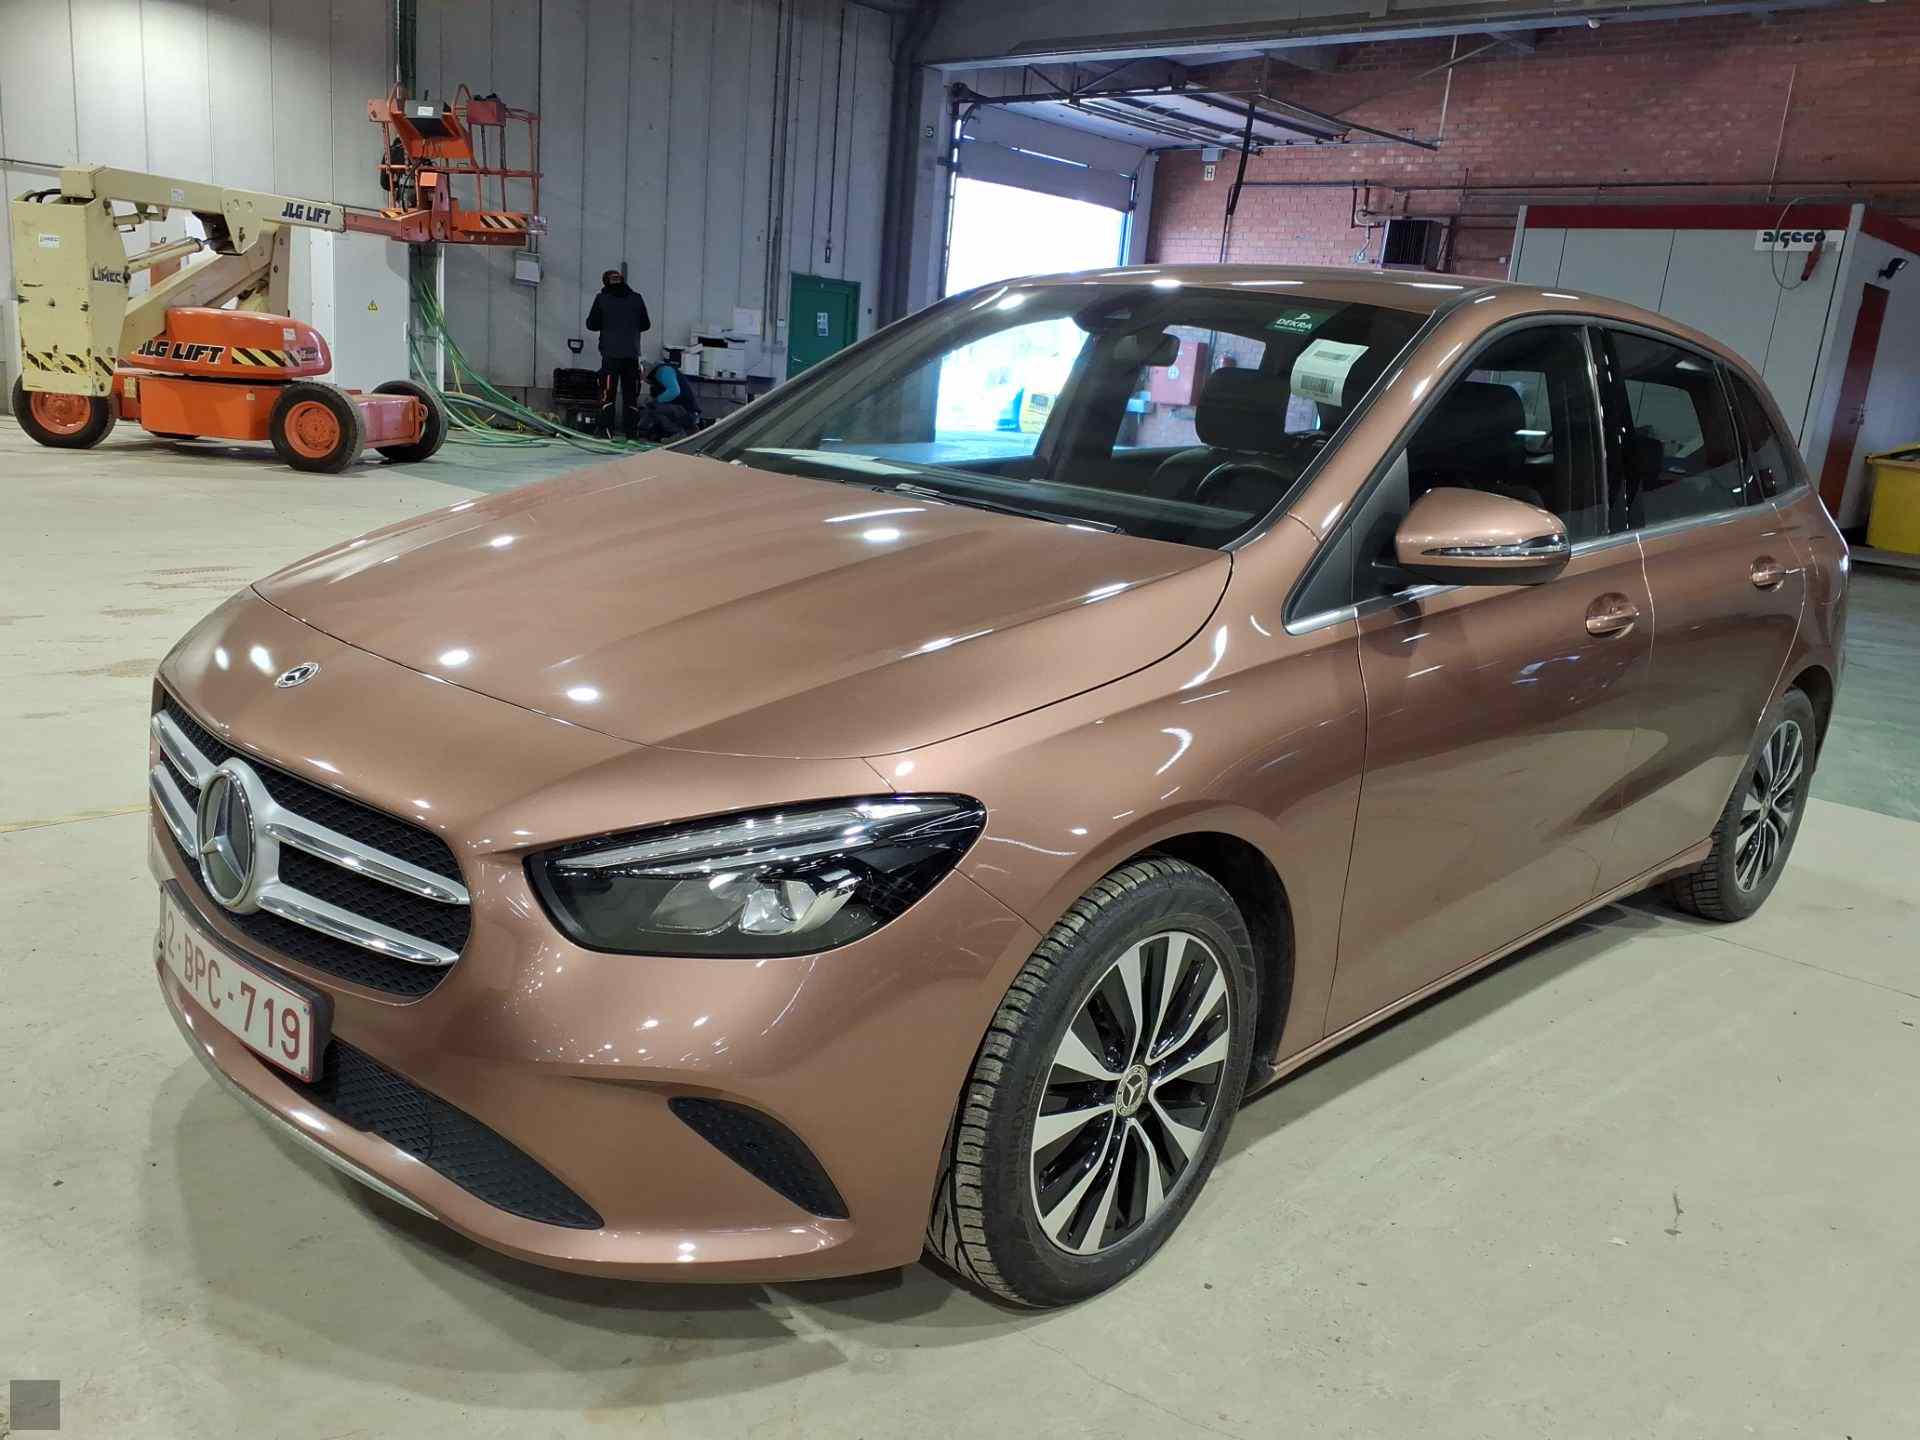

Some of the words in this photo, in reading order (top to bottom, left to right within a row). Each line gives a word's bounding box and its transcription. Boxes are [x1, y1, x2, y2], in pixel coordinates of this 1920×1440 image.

[282, 202, 304, 219] JLG
[306, 206, 331, 224] LIFT
[1762, 231, 1826, 249] algeco
[1276, 318, 1312, 330] DEKRA
[137, 340, 170, 357] JLG
[172, 343, 225, 363] LIFT
[165, 910, 300, 1060] 2-BPC-719
